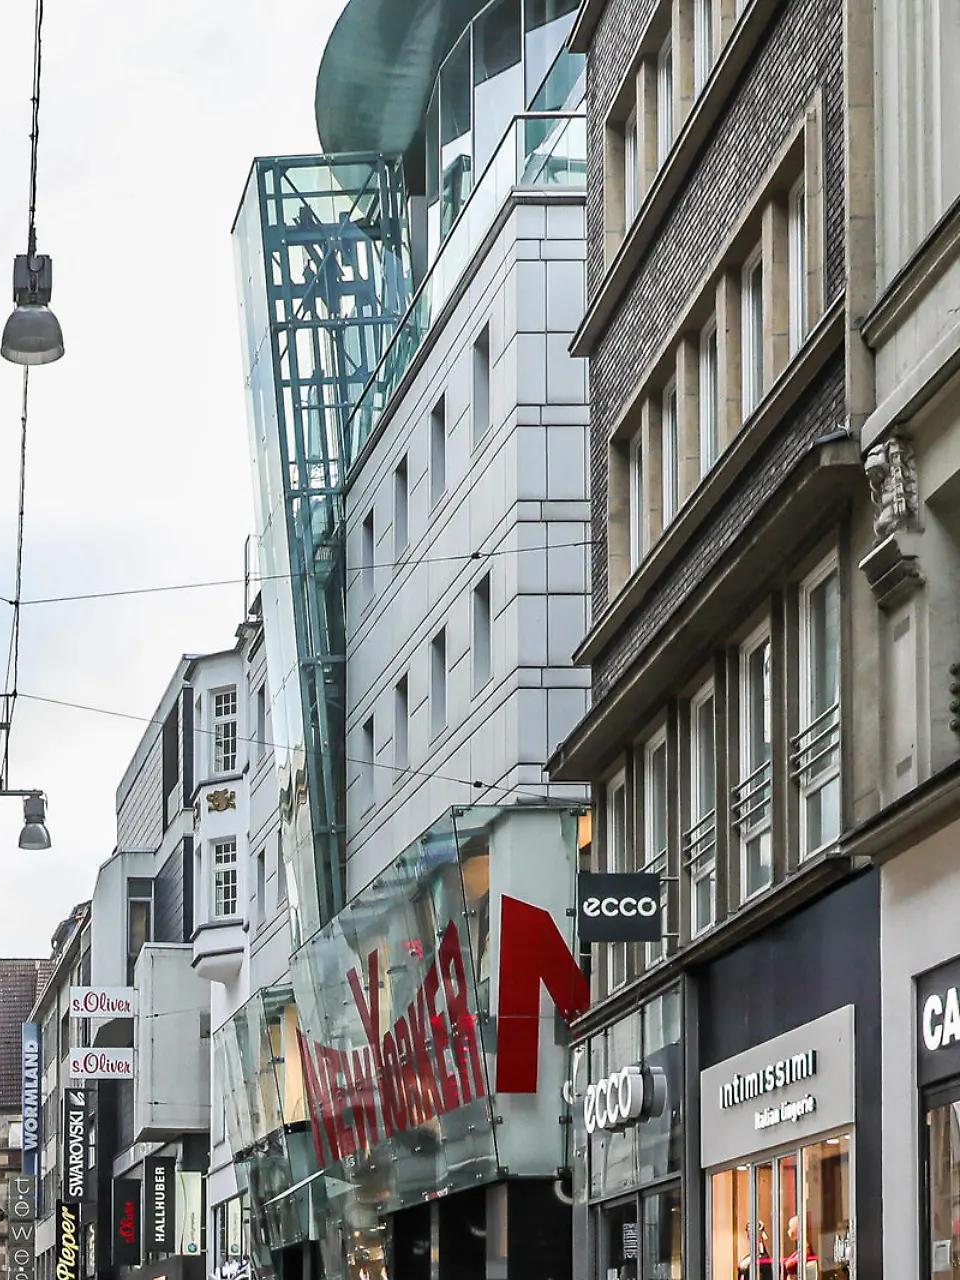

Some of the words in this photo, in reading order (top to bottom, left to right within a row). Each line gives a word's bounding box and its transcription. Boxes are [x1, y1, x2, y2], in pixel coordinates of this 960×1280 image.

[582, 896, 657, 917] ecco
[73, 991, 131, 1012] s.Oliver
[24, 1040, 39, 1150] WORMLAND
[72, 1052, 130, 1074] s.Oliver
[584, 1066, 637, 1134] ecco
[70, 1111, 83, 1197] SWAROVSKI
[155, 1166, 165, 1242] HALLHUBER
